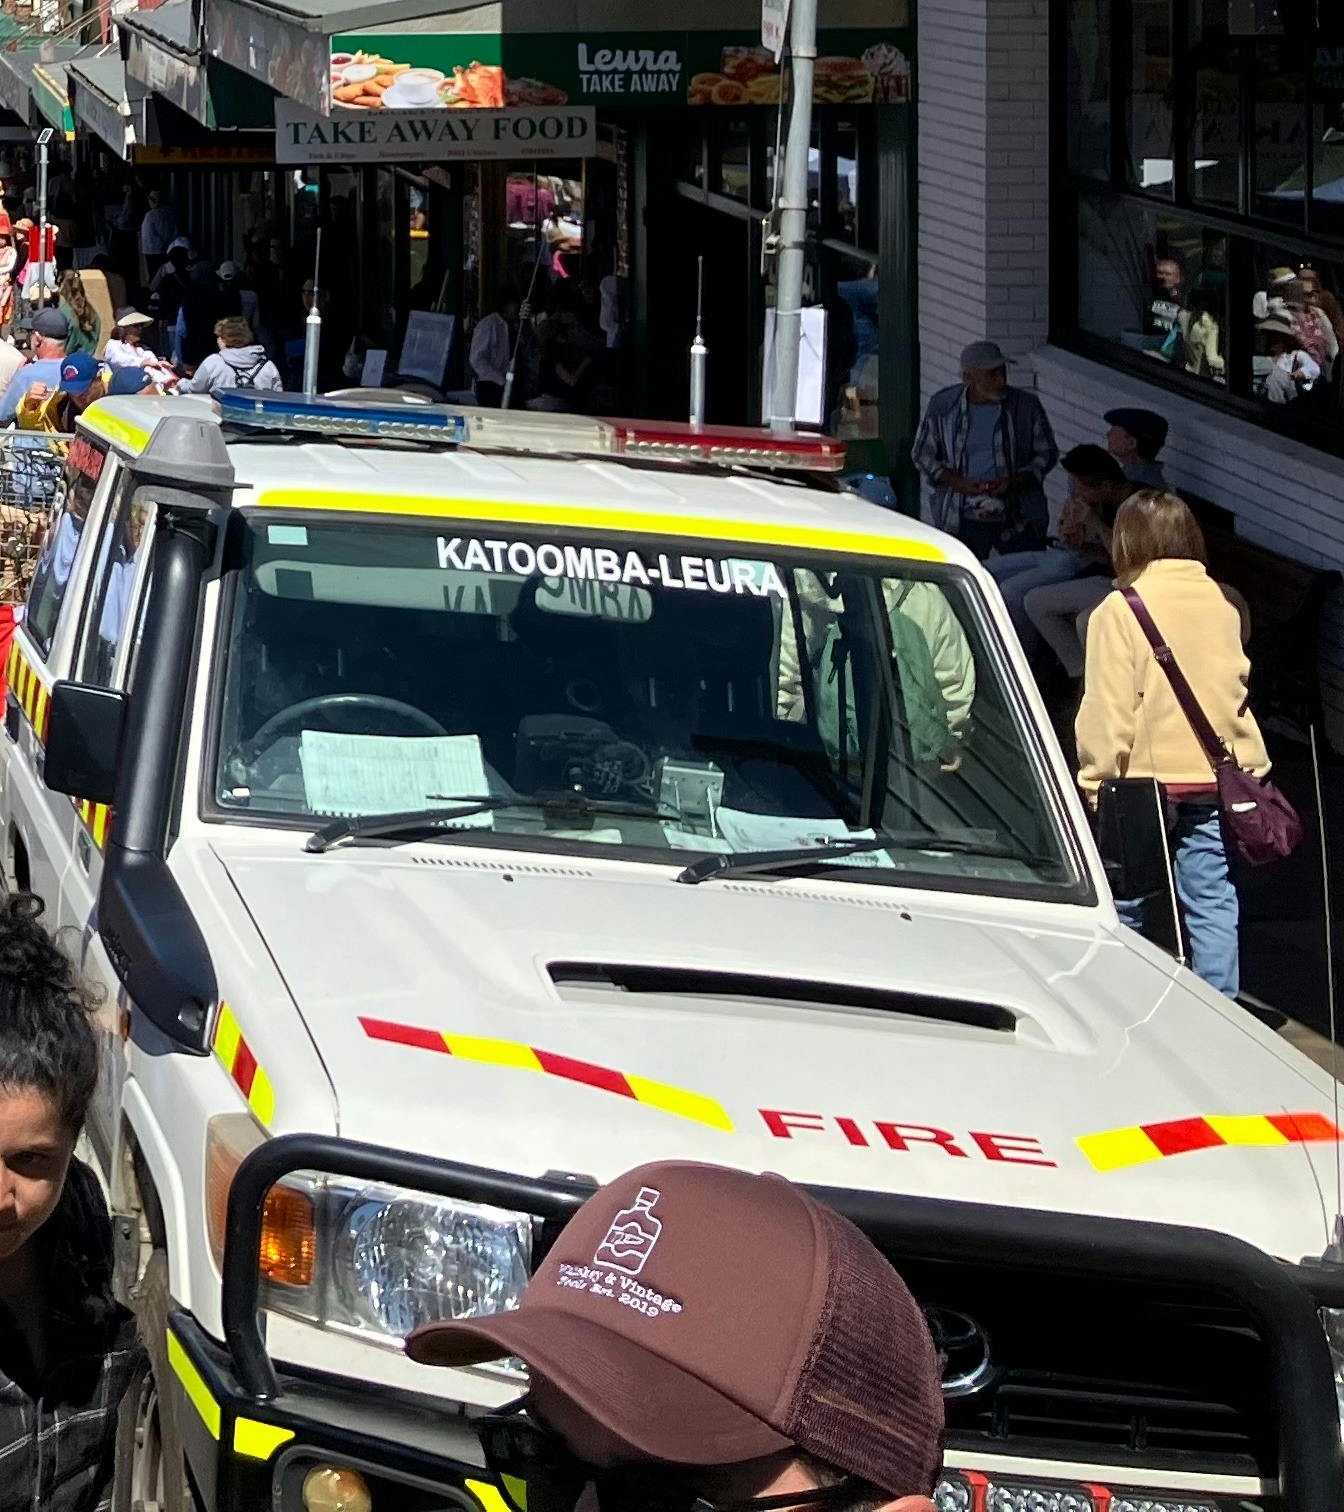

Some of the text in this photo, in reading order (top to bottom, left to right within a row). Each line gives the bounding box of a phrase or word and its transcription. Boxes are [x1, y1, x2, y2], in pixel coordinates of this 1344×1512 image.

[578, 42, 682, 72] Leura
[579, 73, 680, 93] TAKE AWAY
[286, 115, 588, 146] TAKE AWAY FOOD
[436, 536, 789, 598] KATOOMBA-LEURA
[757, 1108, 1059, 1169] FIRE
[604, 1271, 617, 1286] &
[620, 1275, 682, 1313] Vintage
[618, 1292, 659, 1317] 2019
